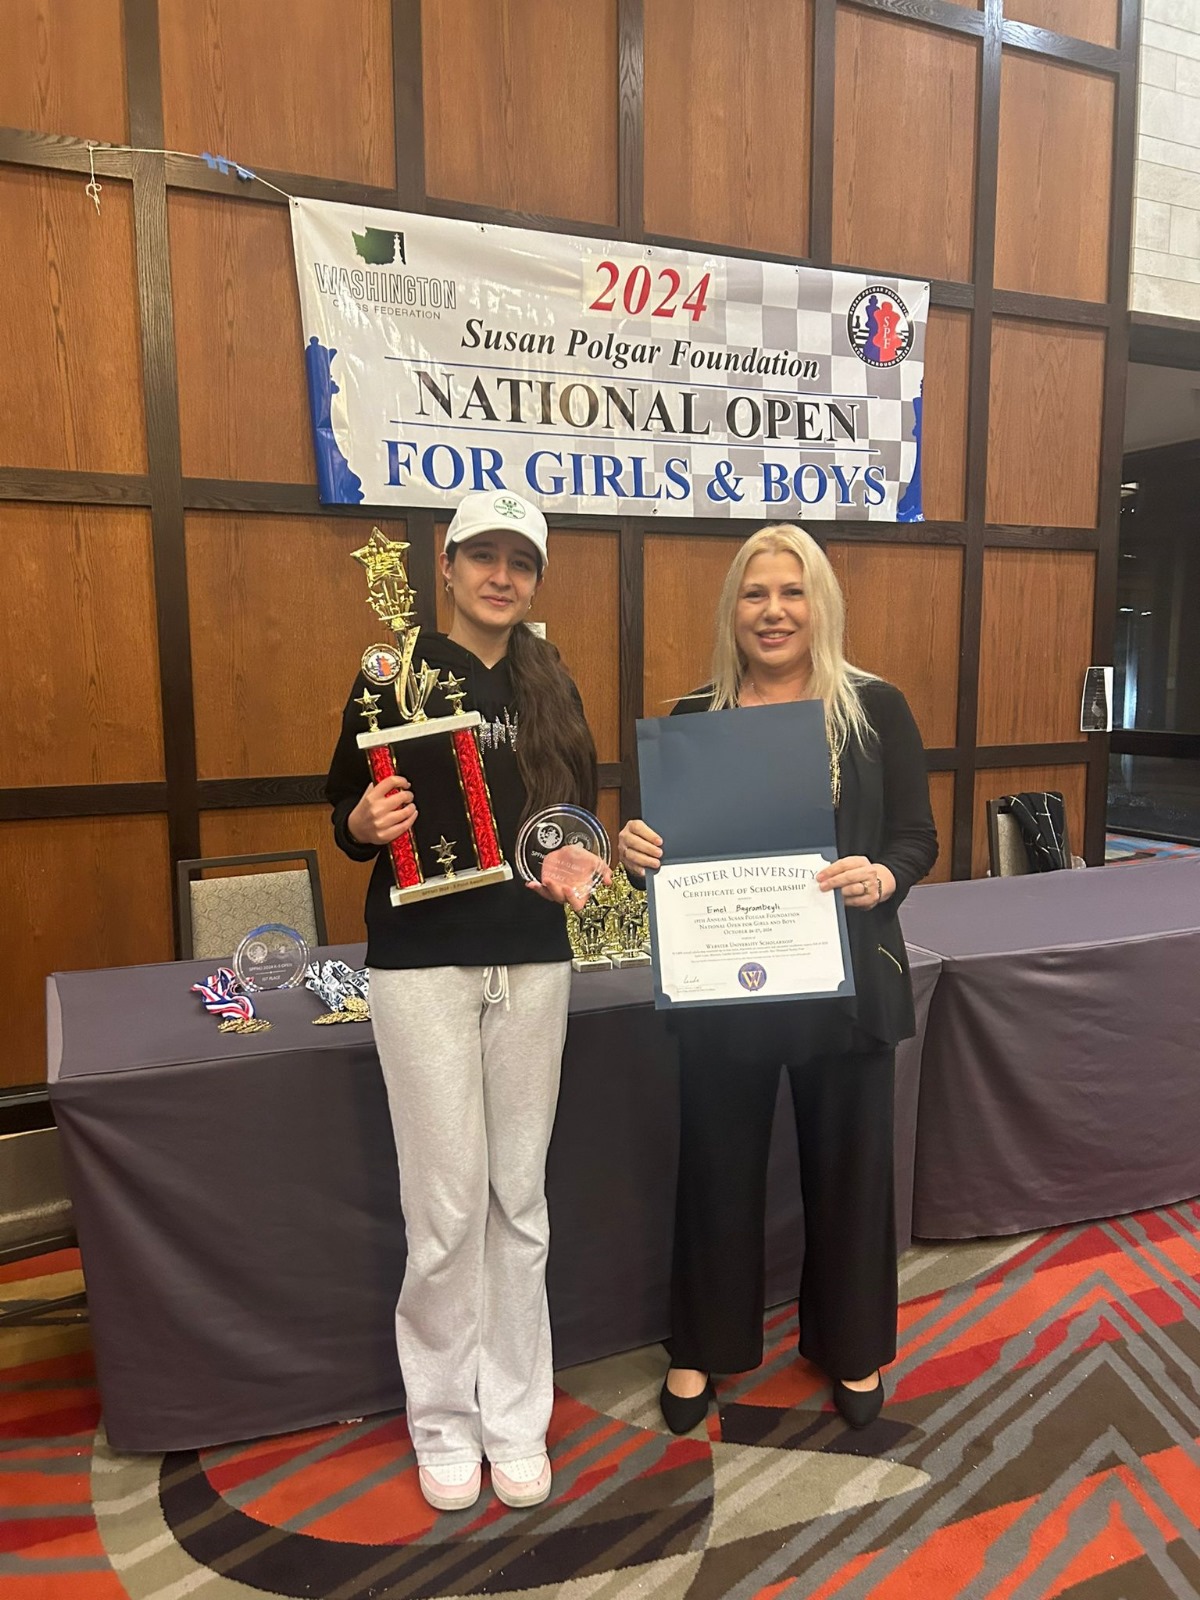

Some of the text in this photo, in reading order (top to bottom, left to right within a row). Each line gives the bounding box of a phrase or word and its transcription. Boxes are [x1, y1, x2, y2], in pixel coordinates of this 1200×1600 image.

[314, 263, 456, 310] WASHINGTON
[588, 260, 711, 322] 2024
[374, 305, 442, 320] FEDERATION
[883, 316, 891, 349] SPF
[460, 318, 820, 379] Susan Polgar Foundation
[414, 370, 859, 443] NATIONAL OPEN
[381, 439, 887, 506] FOR GIRLS & BOYS
[668, 866, 819, 890] WEBSTER UNIVERSITY
[682, 883, 807, 899] CERTIFICATE OF SCHOLARSHIP
[729, 941, 758, 949] UNIVERSITY
